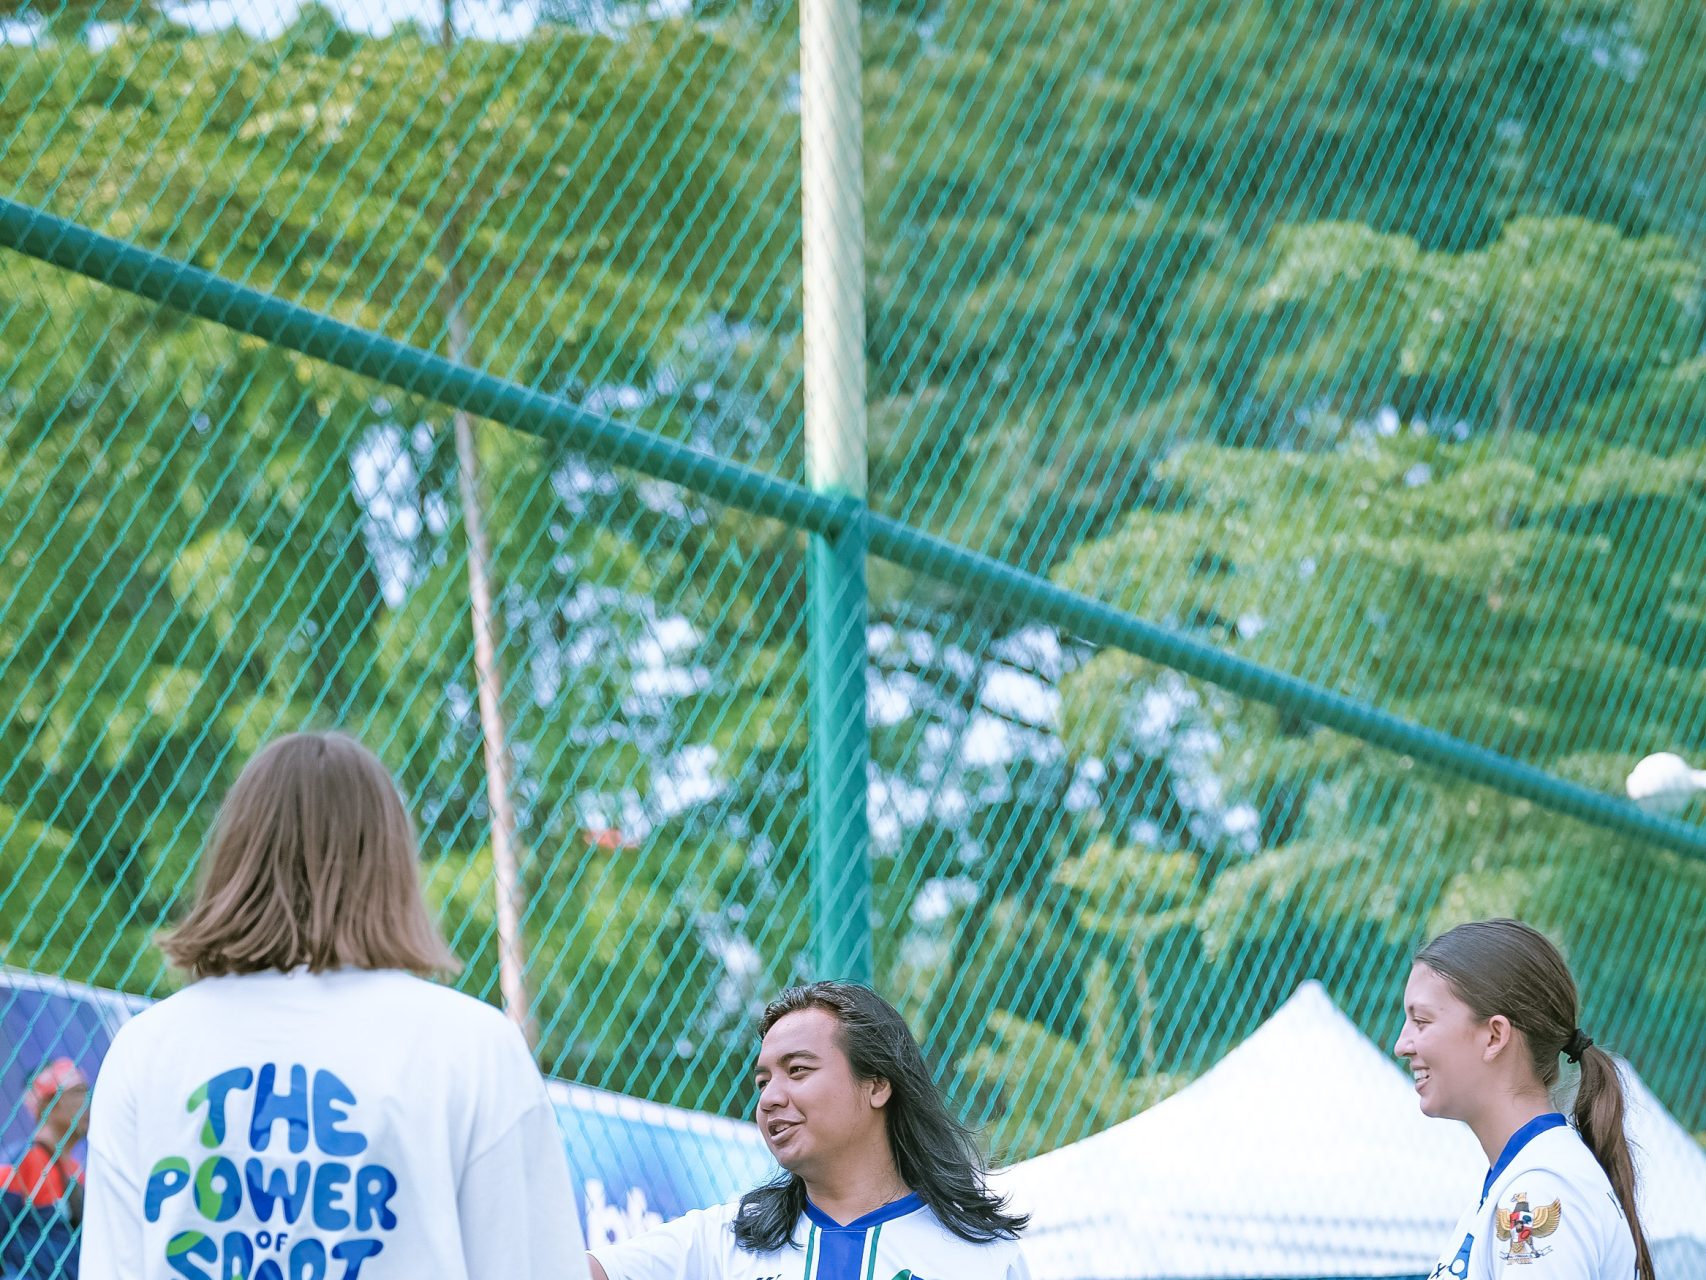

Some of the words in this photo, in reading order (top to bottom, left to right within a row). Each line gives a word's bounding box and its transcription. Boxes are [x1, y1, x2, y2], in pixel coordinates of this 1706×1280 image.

[187, 1062, 368, 1157] THE
[144, 1155, 397, 1232] POWER
[255, 1231, 288, 1252] OF
